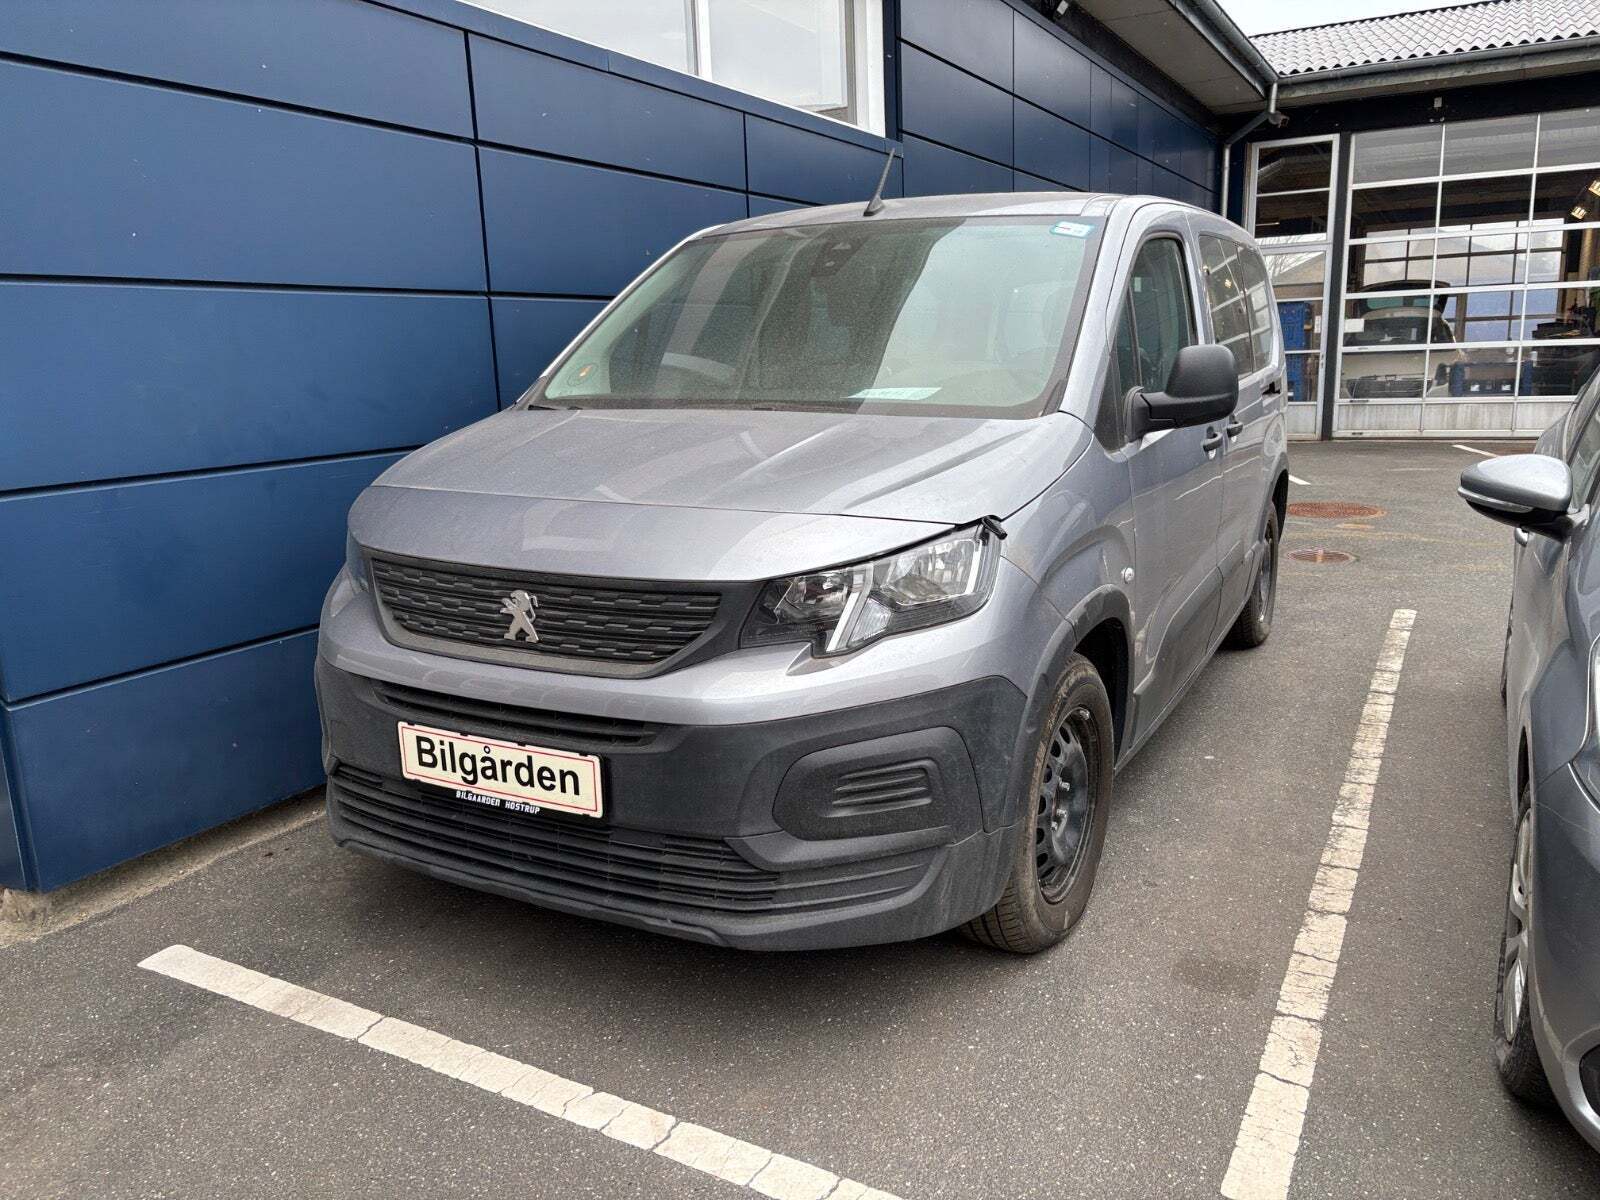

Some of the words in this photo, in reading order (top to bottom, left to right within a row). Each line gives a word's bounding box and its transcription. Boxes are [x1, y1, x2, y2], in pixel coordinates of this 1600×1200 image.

[416, 735, 580, 796] Bilgården
[456, 790, 500, 807] BILGAARDEN
[505, 801, 540, 814] HOSTRUP
